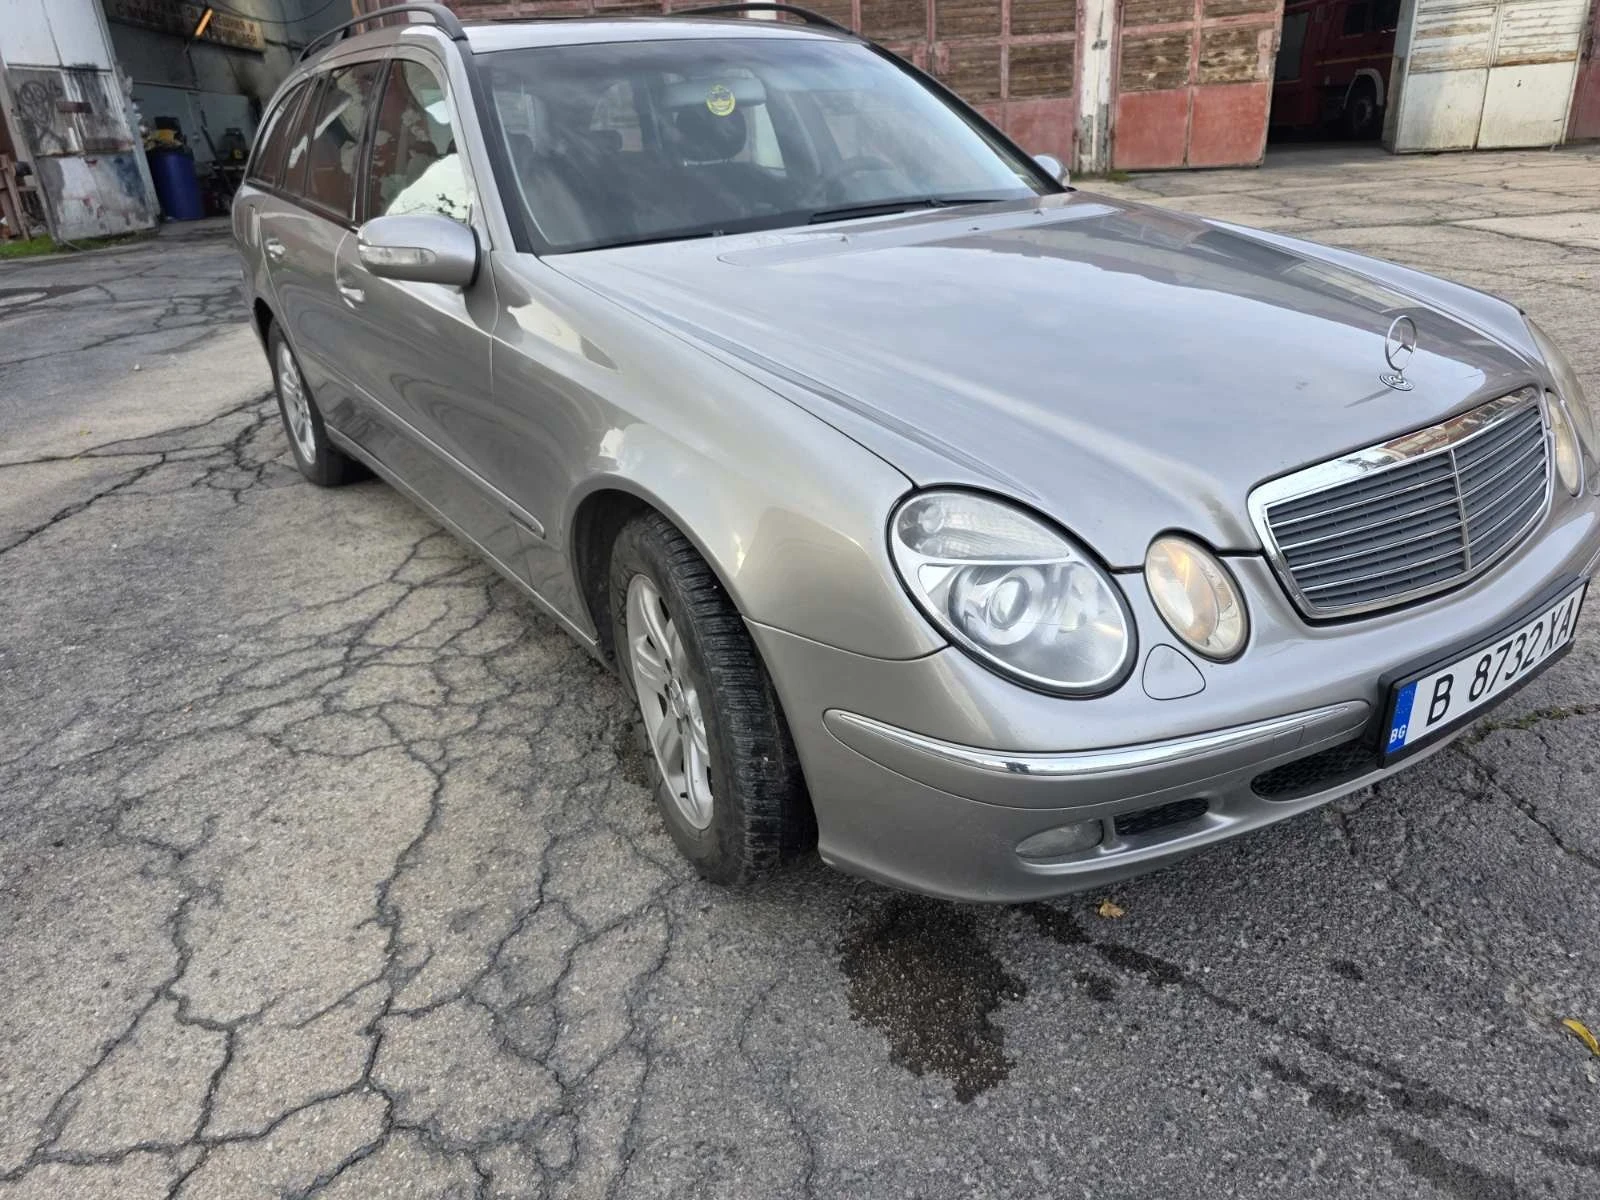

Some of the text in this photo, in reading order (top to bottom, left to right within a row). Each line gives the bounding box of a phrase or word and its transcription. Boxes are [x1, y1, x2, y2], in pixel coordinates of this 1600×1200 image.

[1426, 597, 1575, 727] B 8732 XA
[1389, 724, 1406, 744] BG
